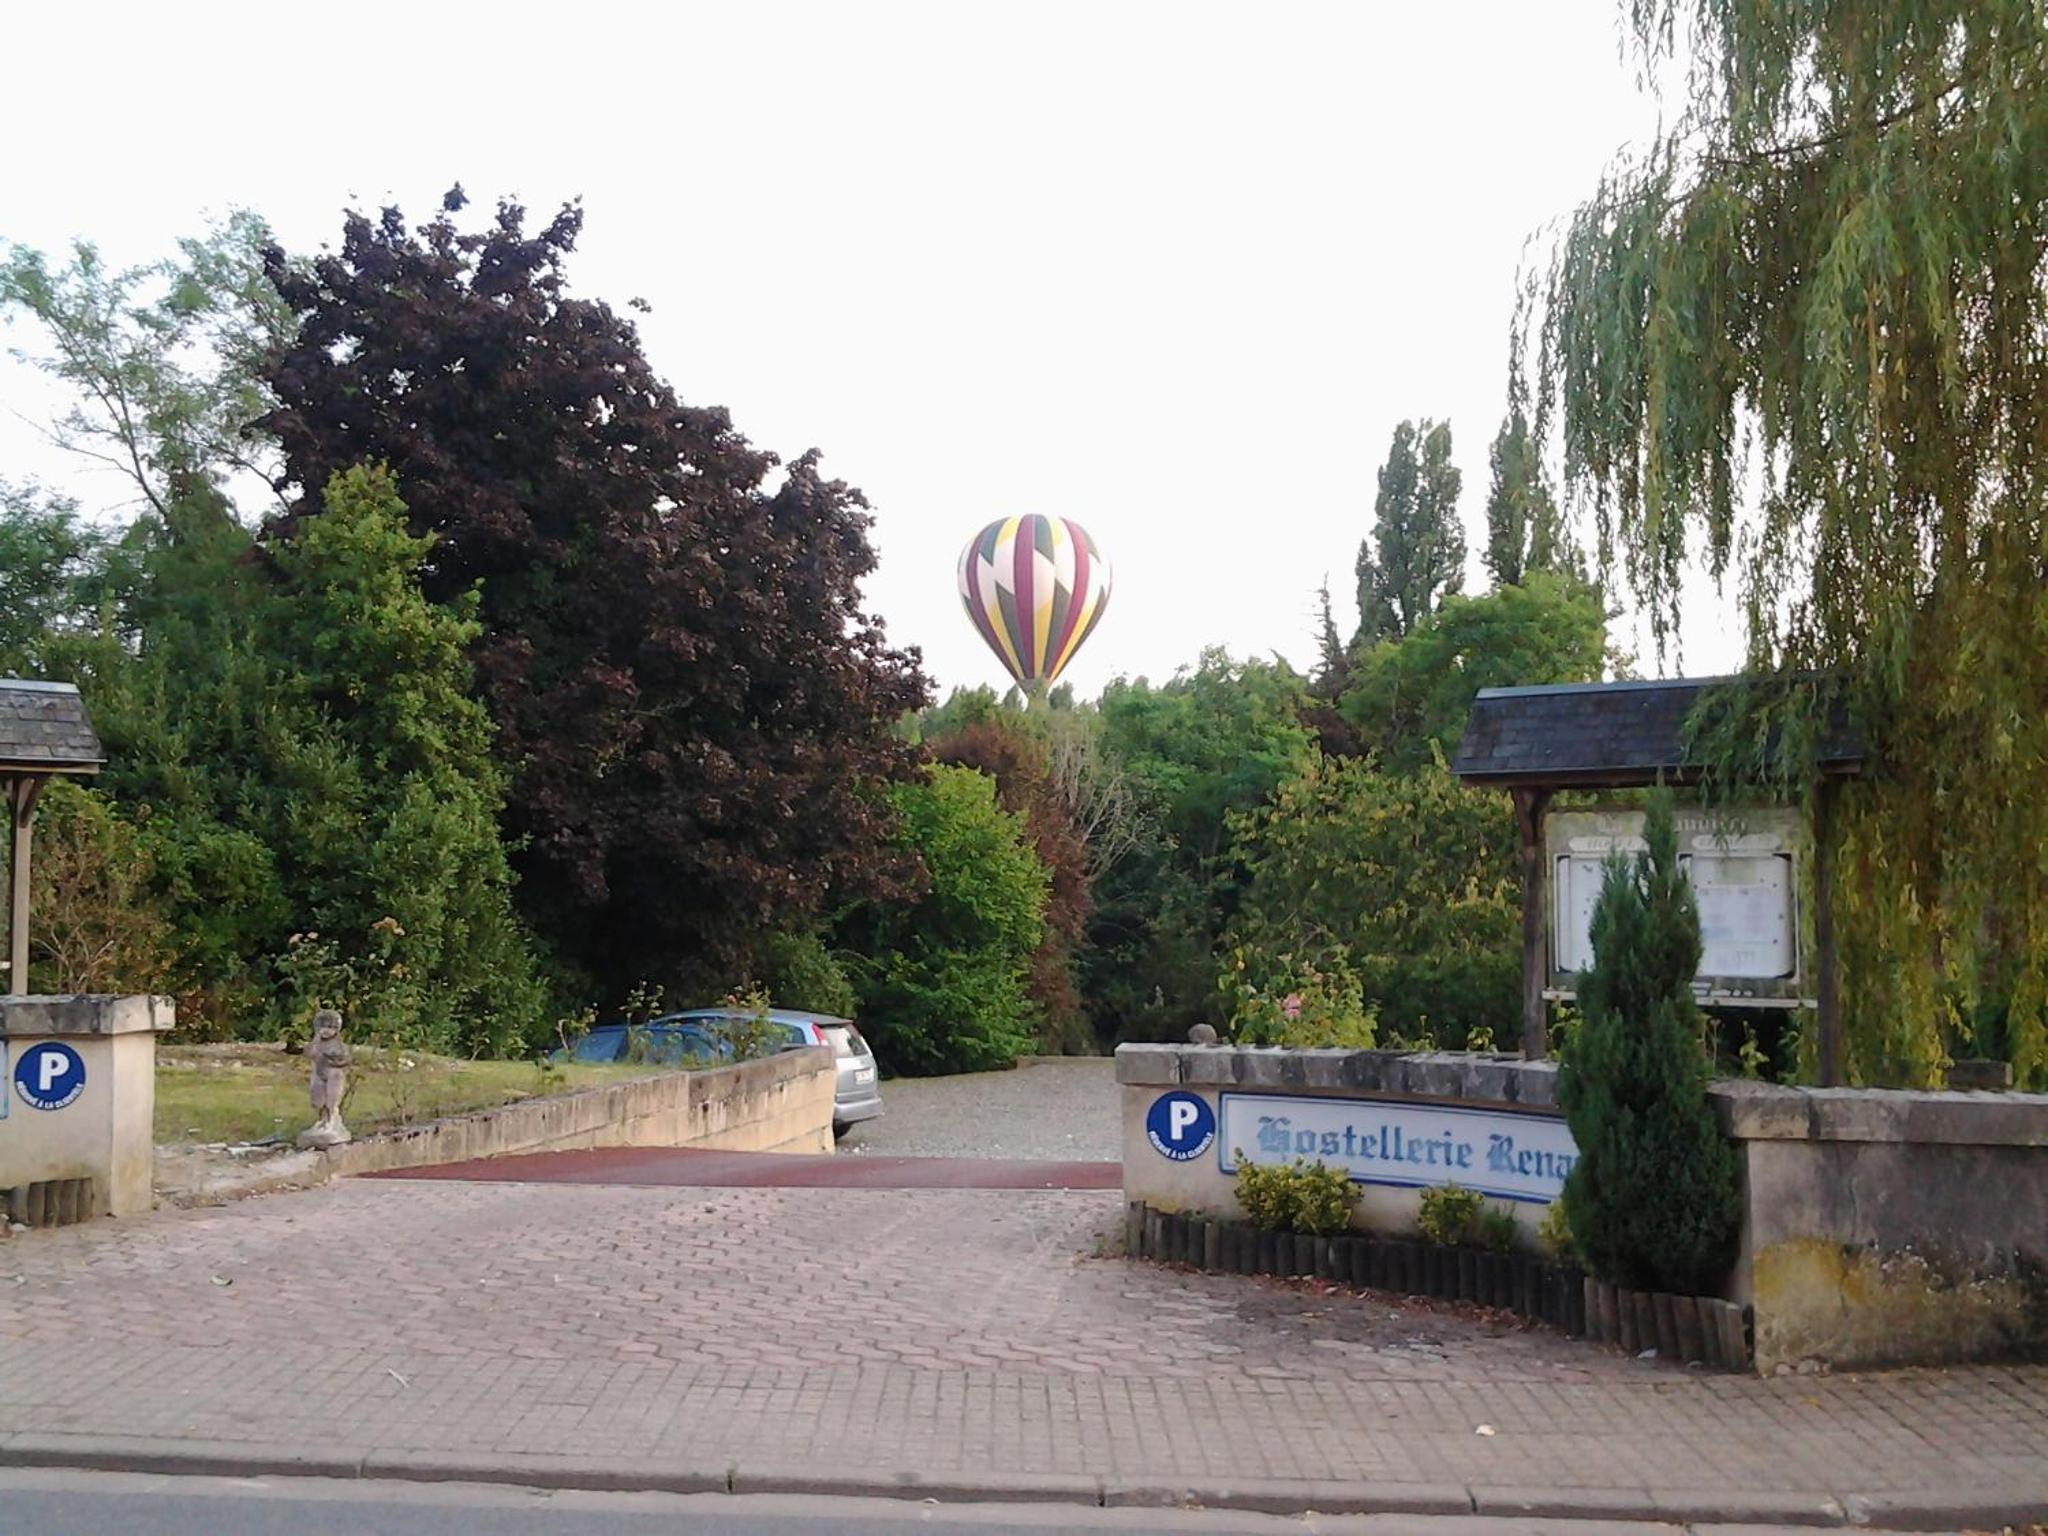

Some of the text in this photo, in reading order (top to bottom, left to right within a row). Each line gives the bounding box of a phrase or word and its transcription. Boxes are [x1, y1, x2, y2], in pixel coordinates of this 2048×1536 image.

[40, 1052, 69, 1090] P
[1170, 1101, 1199, 1140] P
[1257, 1116, 1473, 1168] Hostellerie
